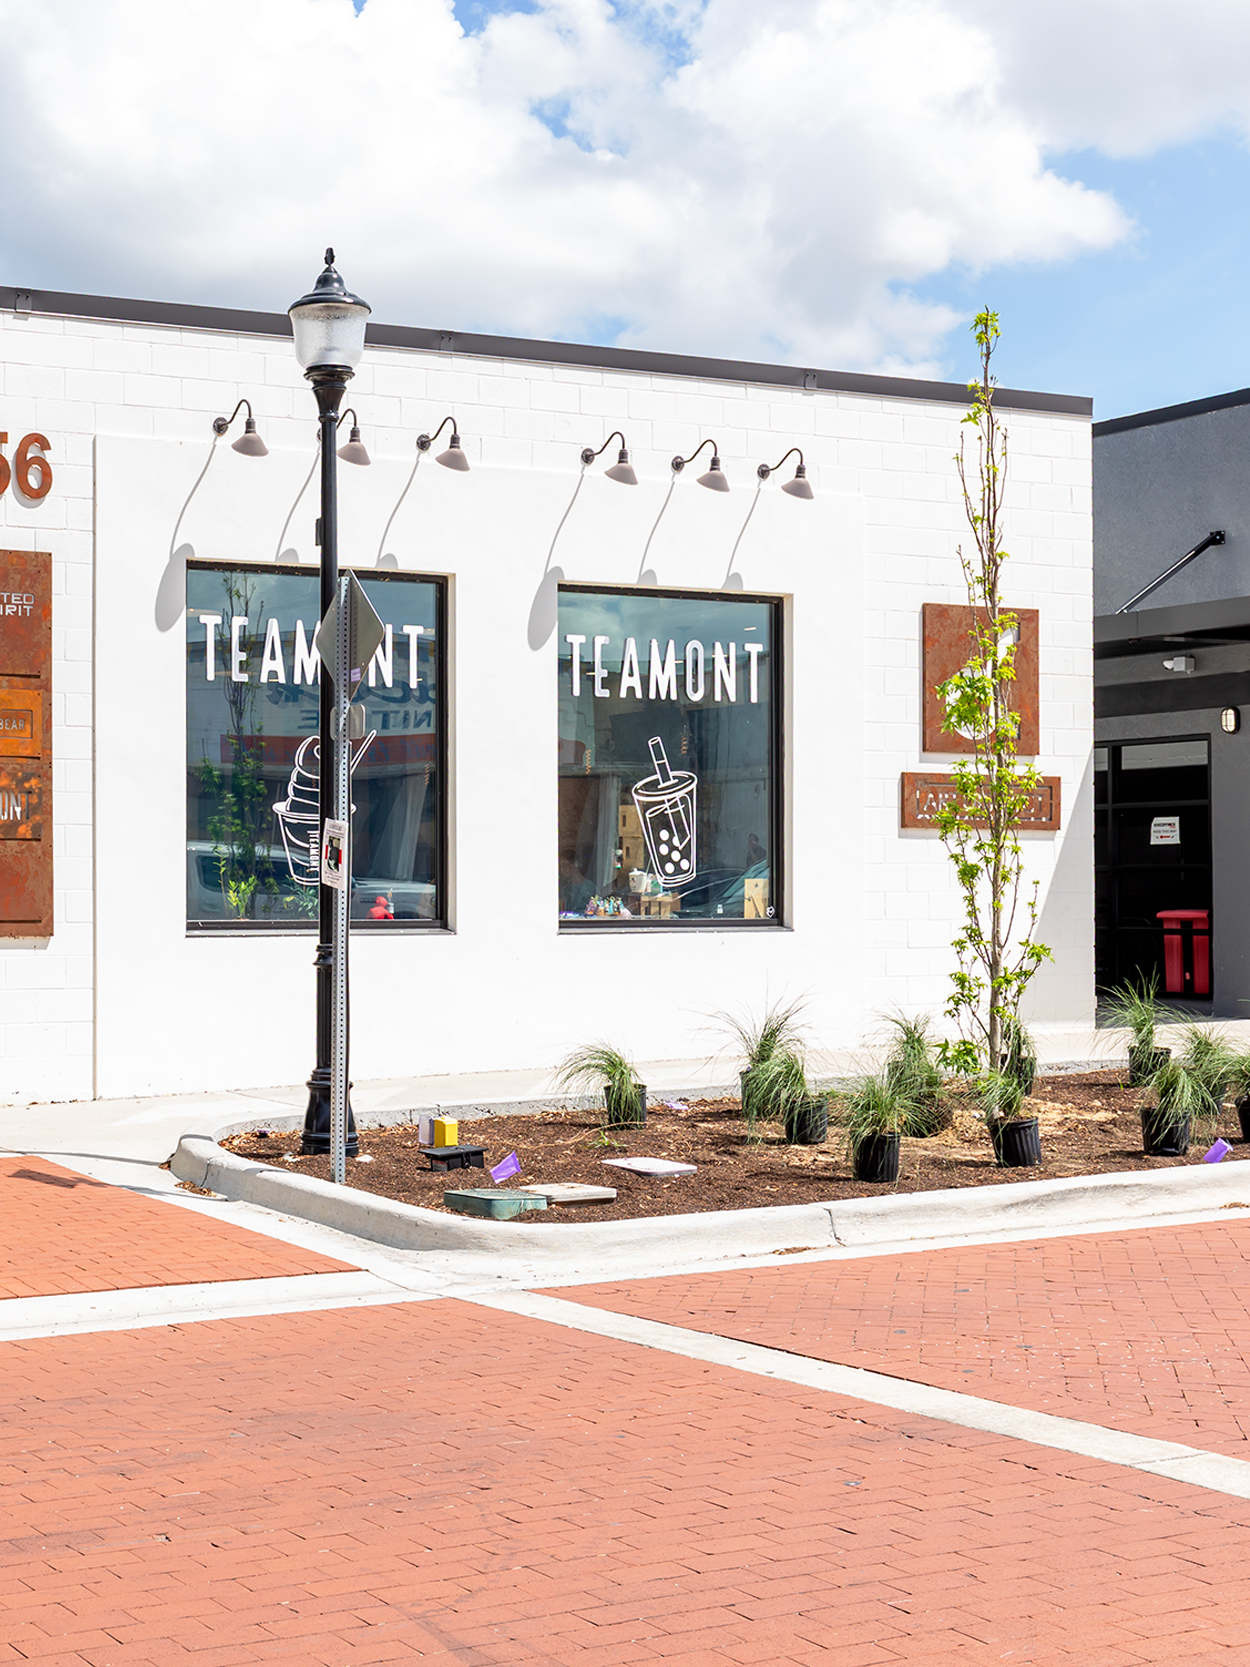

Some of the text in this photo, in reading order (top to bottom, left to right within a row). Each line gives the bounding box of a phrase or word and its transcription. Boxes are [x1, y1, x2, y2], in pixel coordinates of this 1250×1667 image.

[199, 614, 424, 689] TEAMNT
[565, 634, 764, 704] TEAMONT
[309, 833, 321, 872] TEAMONT
